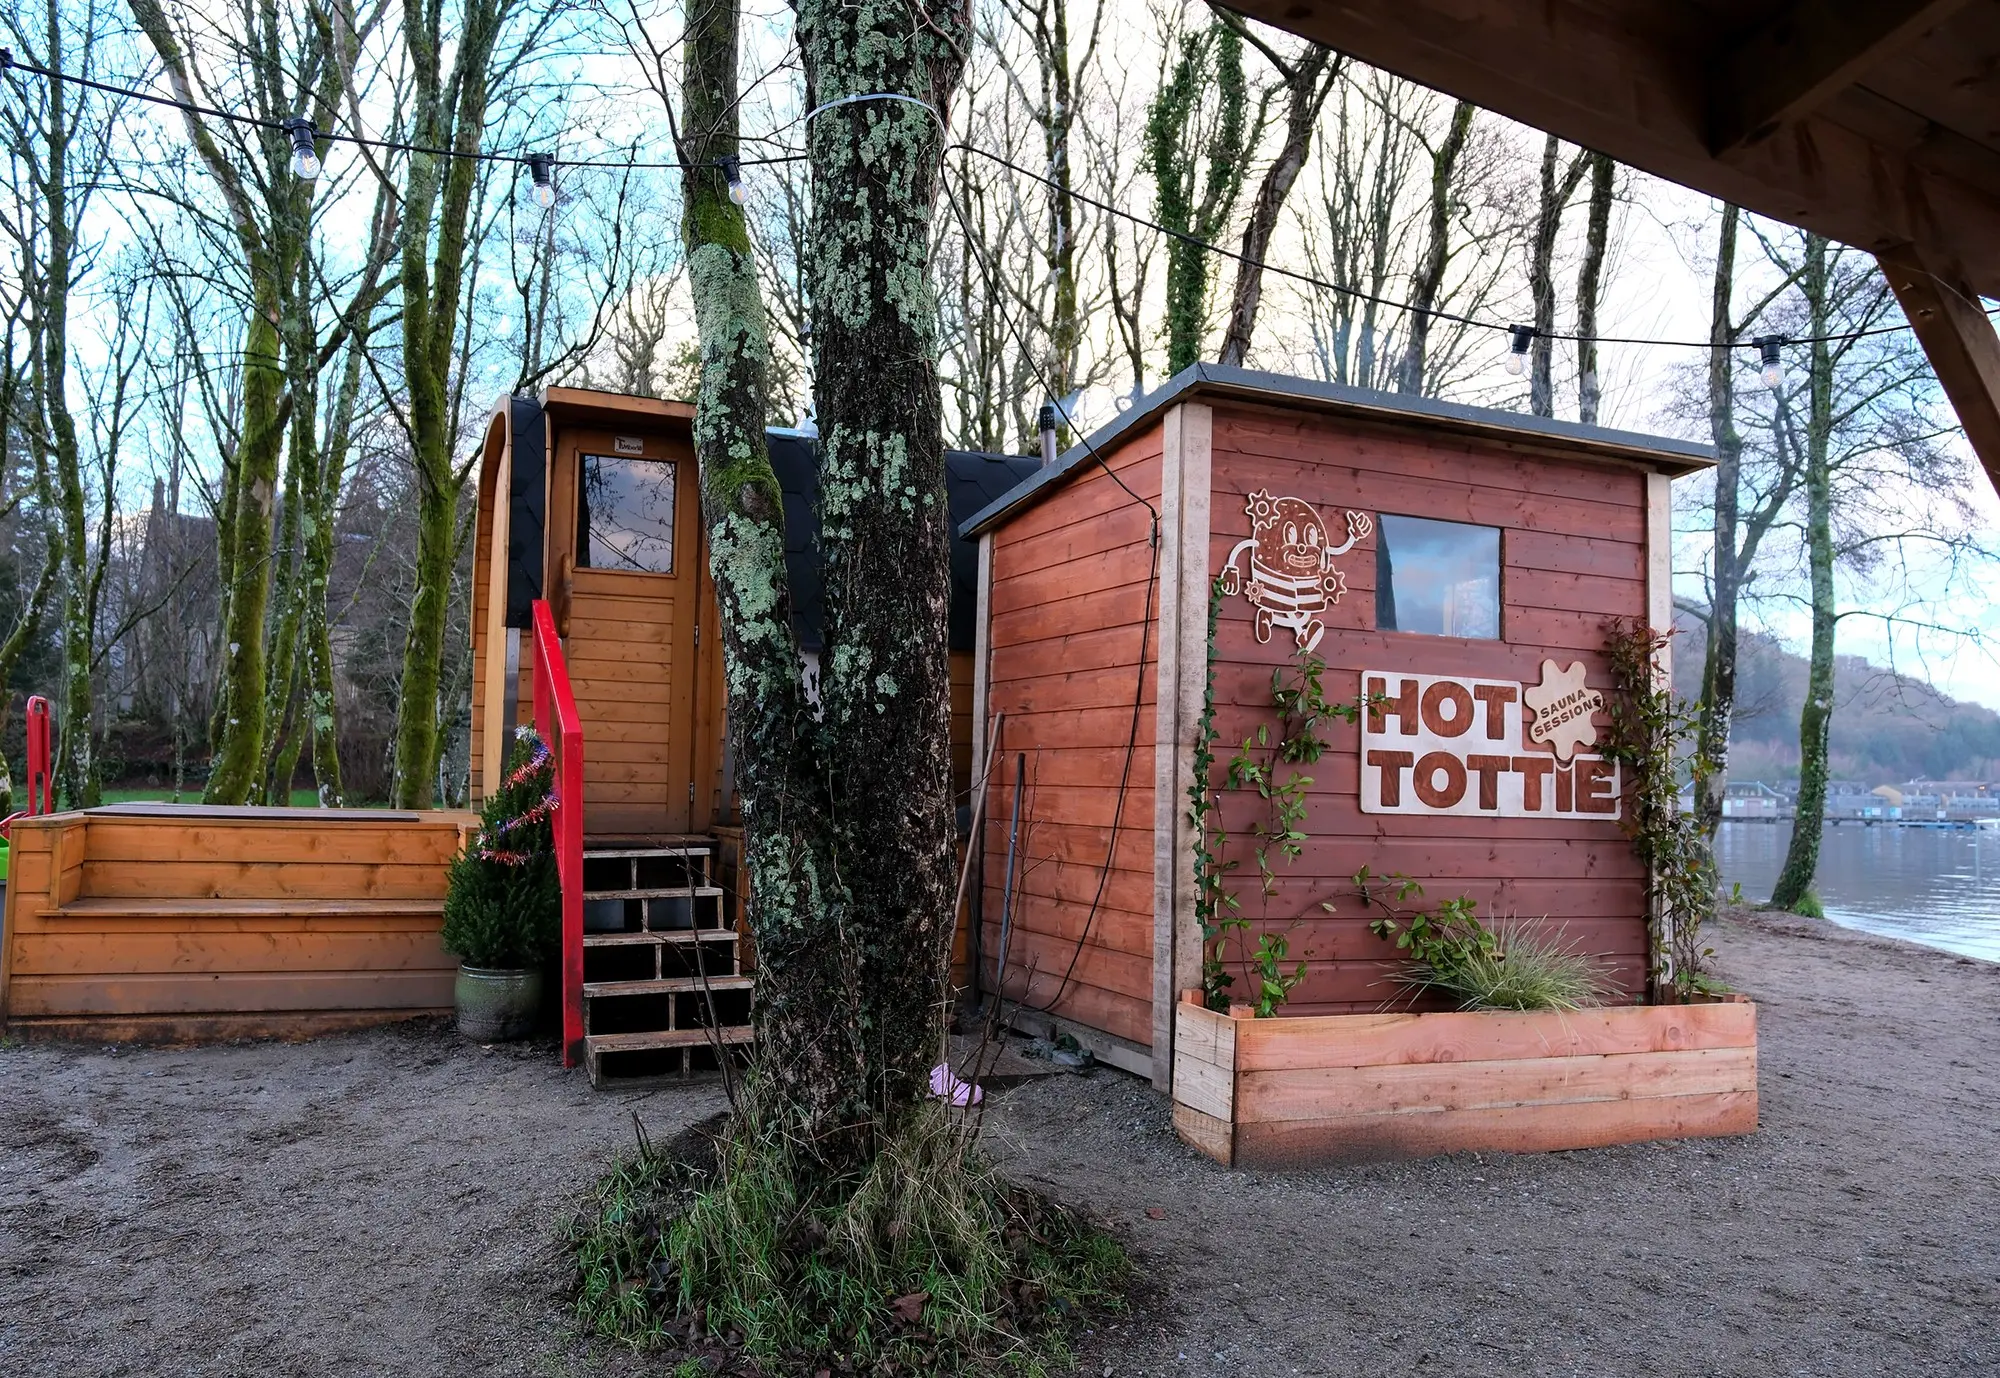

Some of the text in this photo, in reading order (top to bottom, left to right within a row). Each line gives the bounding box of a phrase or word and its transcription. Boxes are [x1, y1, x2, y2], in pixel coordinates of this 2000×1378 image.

[1367, 677, 1517, 740] HOT
[1534, 695, 1600, 737] SESSIONS
[1540, 689, 1586, 718] SAUNA
[1367, 750, 1615, 813] TOTTIE
